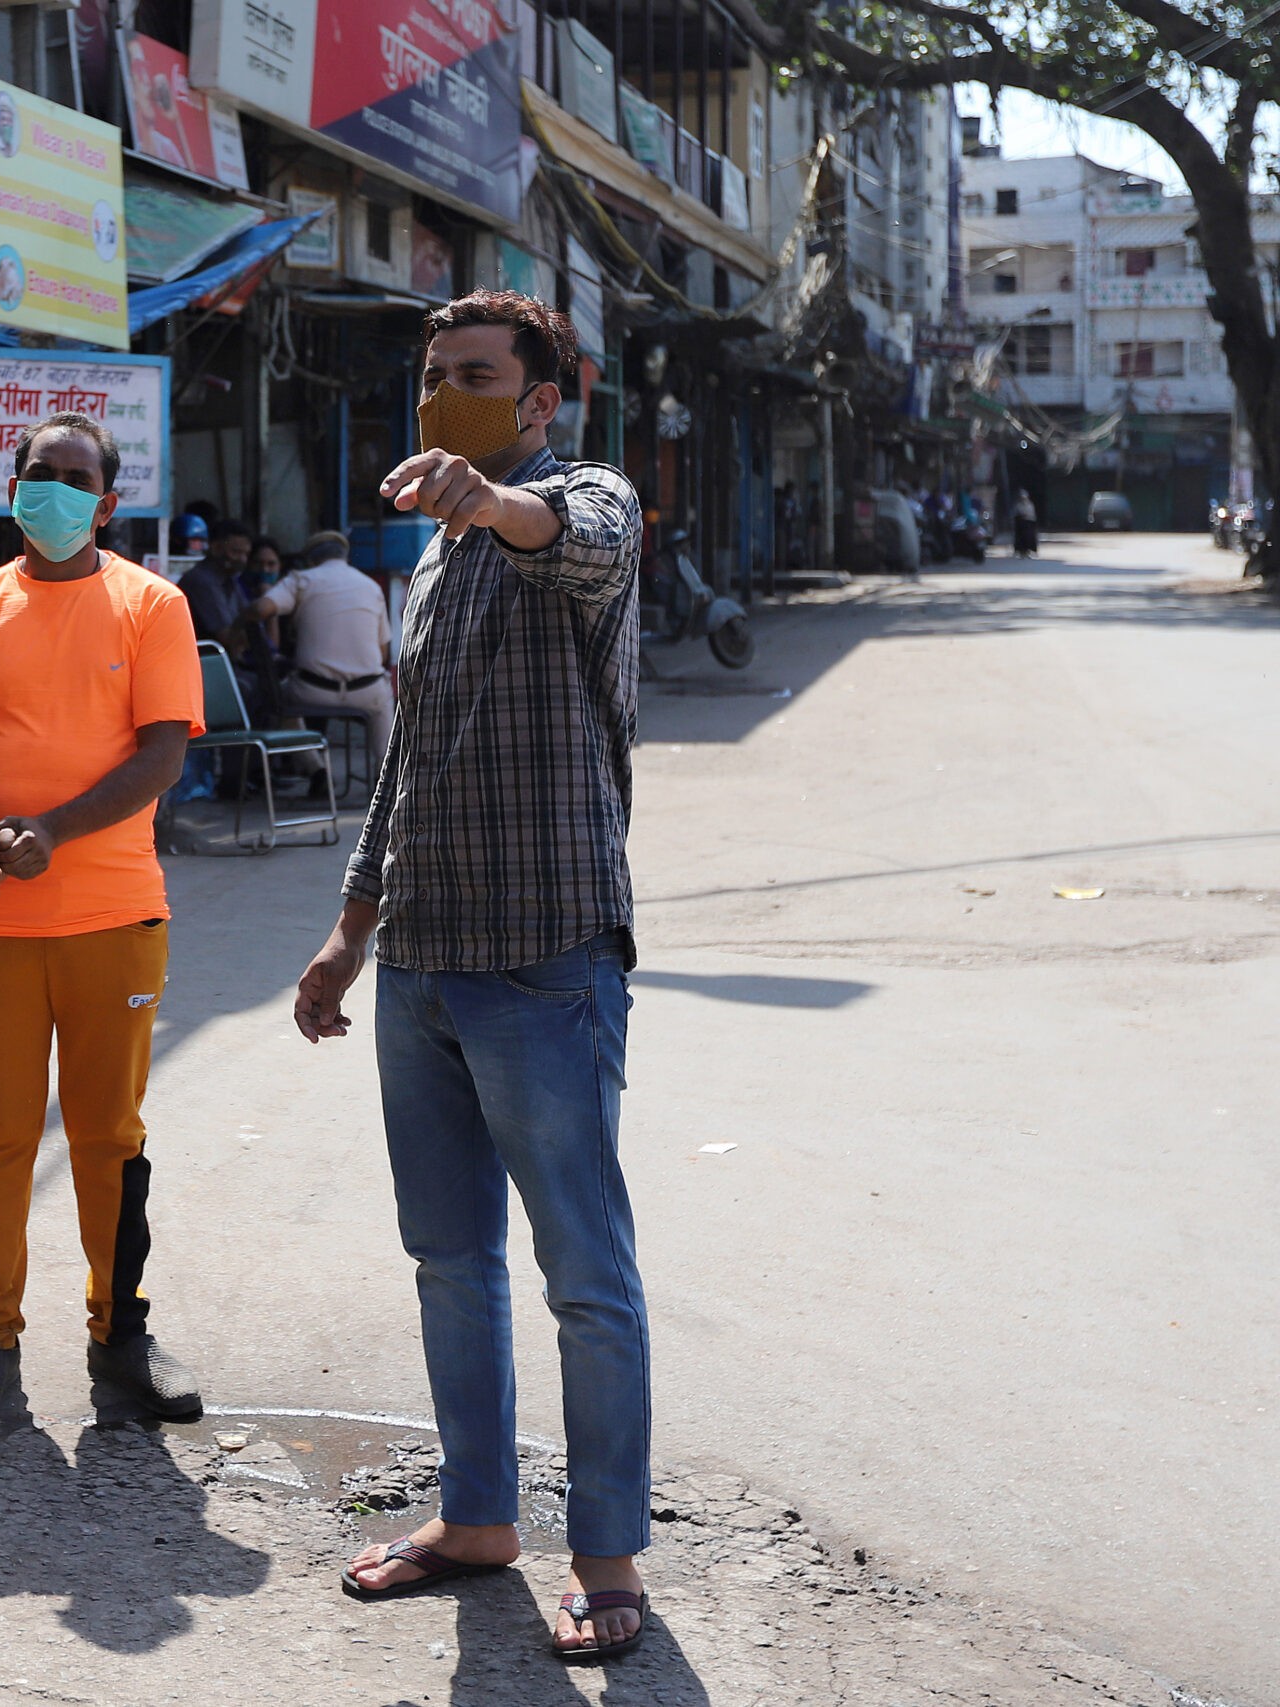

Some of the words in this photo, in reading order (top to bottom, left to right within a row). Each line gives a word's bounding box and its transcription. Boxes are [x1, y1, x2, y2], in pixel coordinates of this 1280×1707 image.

[378, 22, 443, 99] पुलिस
[443, 59, 491, 128] चौकी
[31, 121, 63, 156] Wear
[76, 138, 107, 171] Mask
[28, 269, 58, 298] Ensure
[61, 280, 83, 304] Hand
[85, 287, 119, 314] Hygiene
[47, 385, 109, 420] ताहिरा
